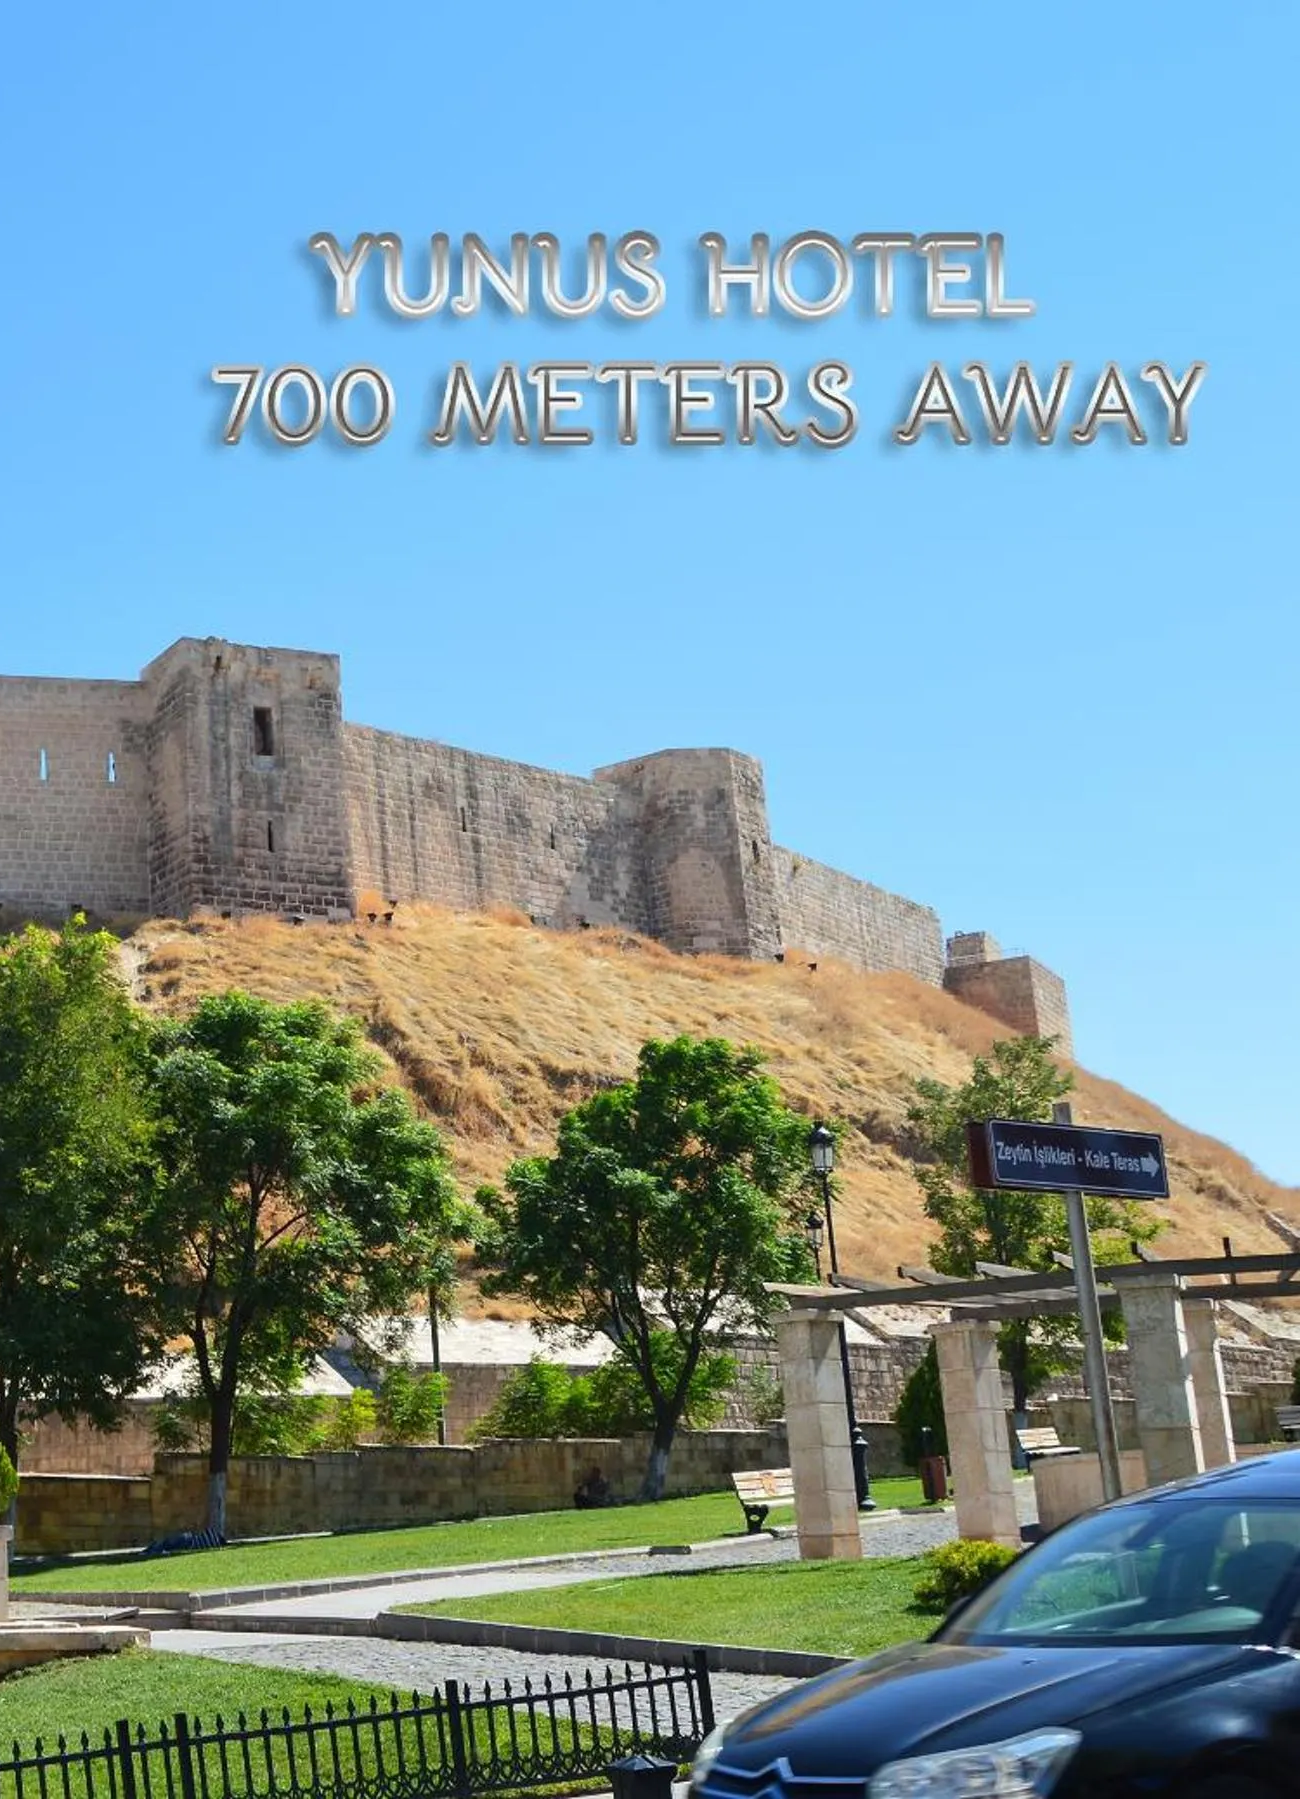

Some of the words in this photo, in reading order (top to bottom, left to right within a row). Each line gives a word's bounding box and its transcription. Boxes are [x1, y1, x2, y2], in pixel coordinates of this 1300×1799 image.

[996, 1141, 1032, 1165] Zeytin
[1084, 1150, 1110, 1169] Kale
[1110, 1151, 1140, 1172] Teras
